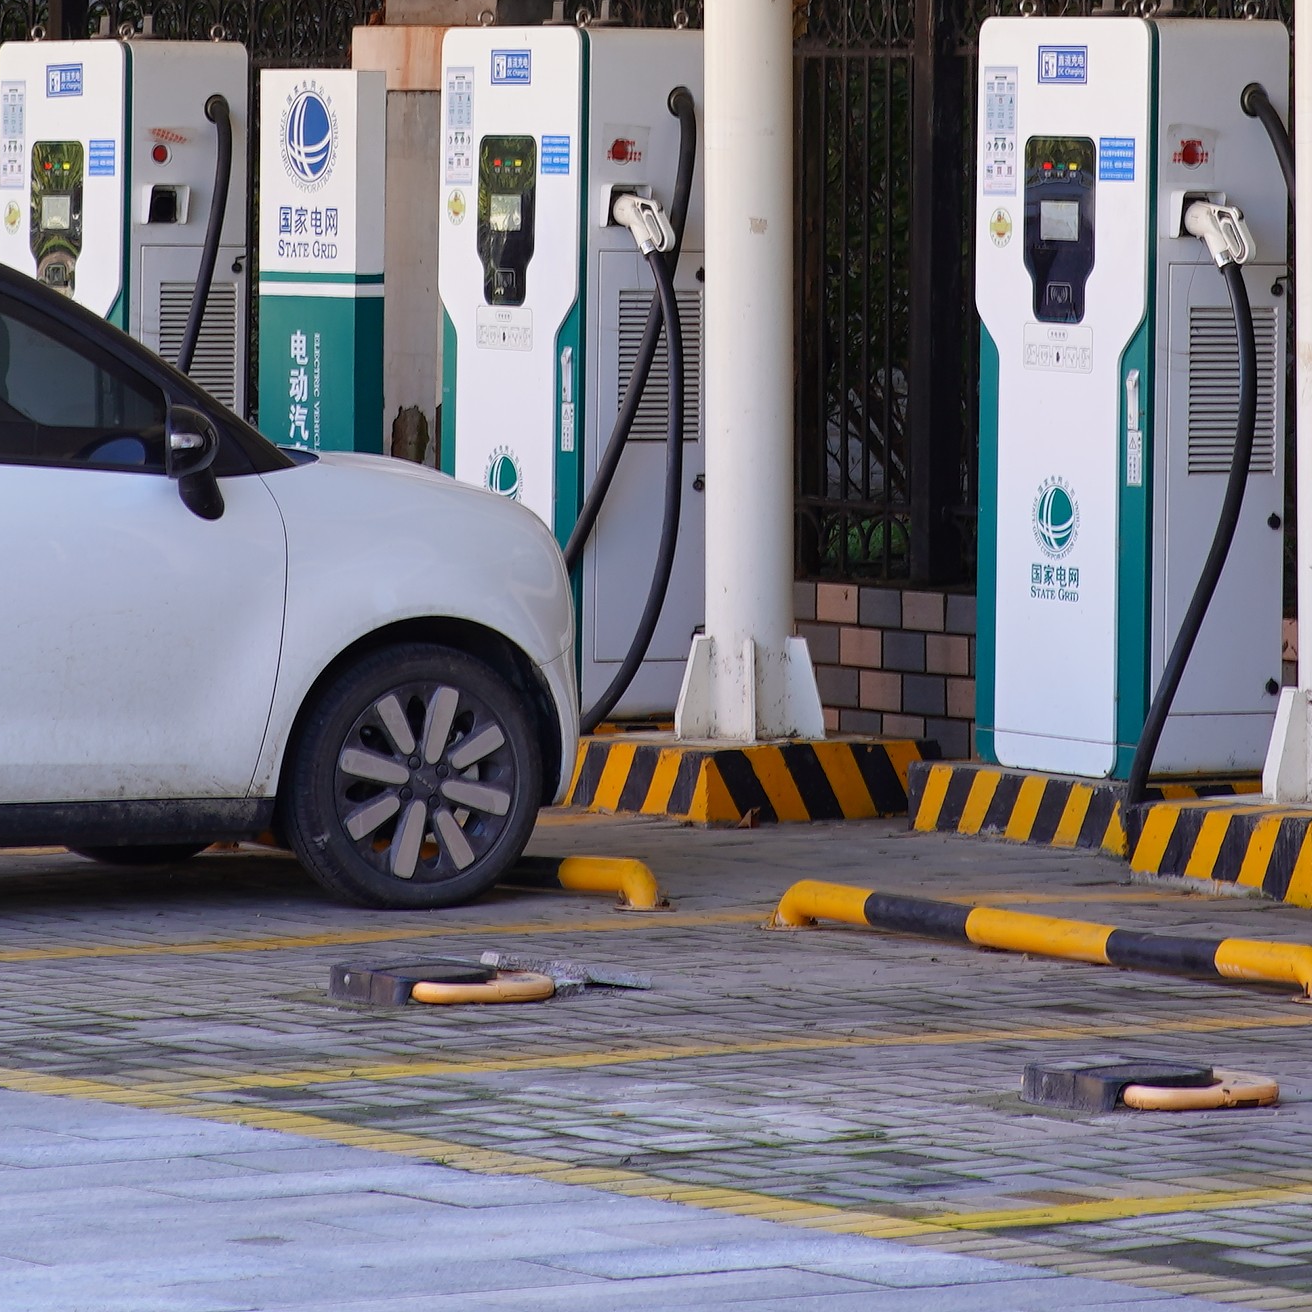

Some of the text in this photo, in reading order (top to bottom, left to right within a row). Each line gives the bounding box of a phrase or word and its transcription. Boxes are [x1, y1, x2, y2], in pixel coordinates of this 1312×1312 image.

[278, 206, 338, 237] 国家电网
[278, 239, 338, 259] STATE GRID
[313, 401, 321, 452] VEHICL
[1031, 563, 1080, 588] 国家电网
[1030, 585, 1079, 603] STATE GRID
